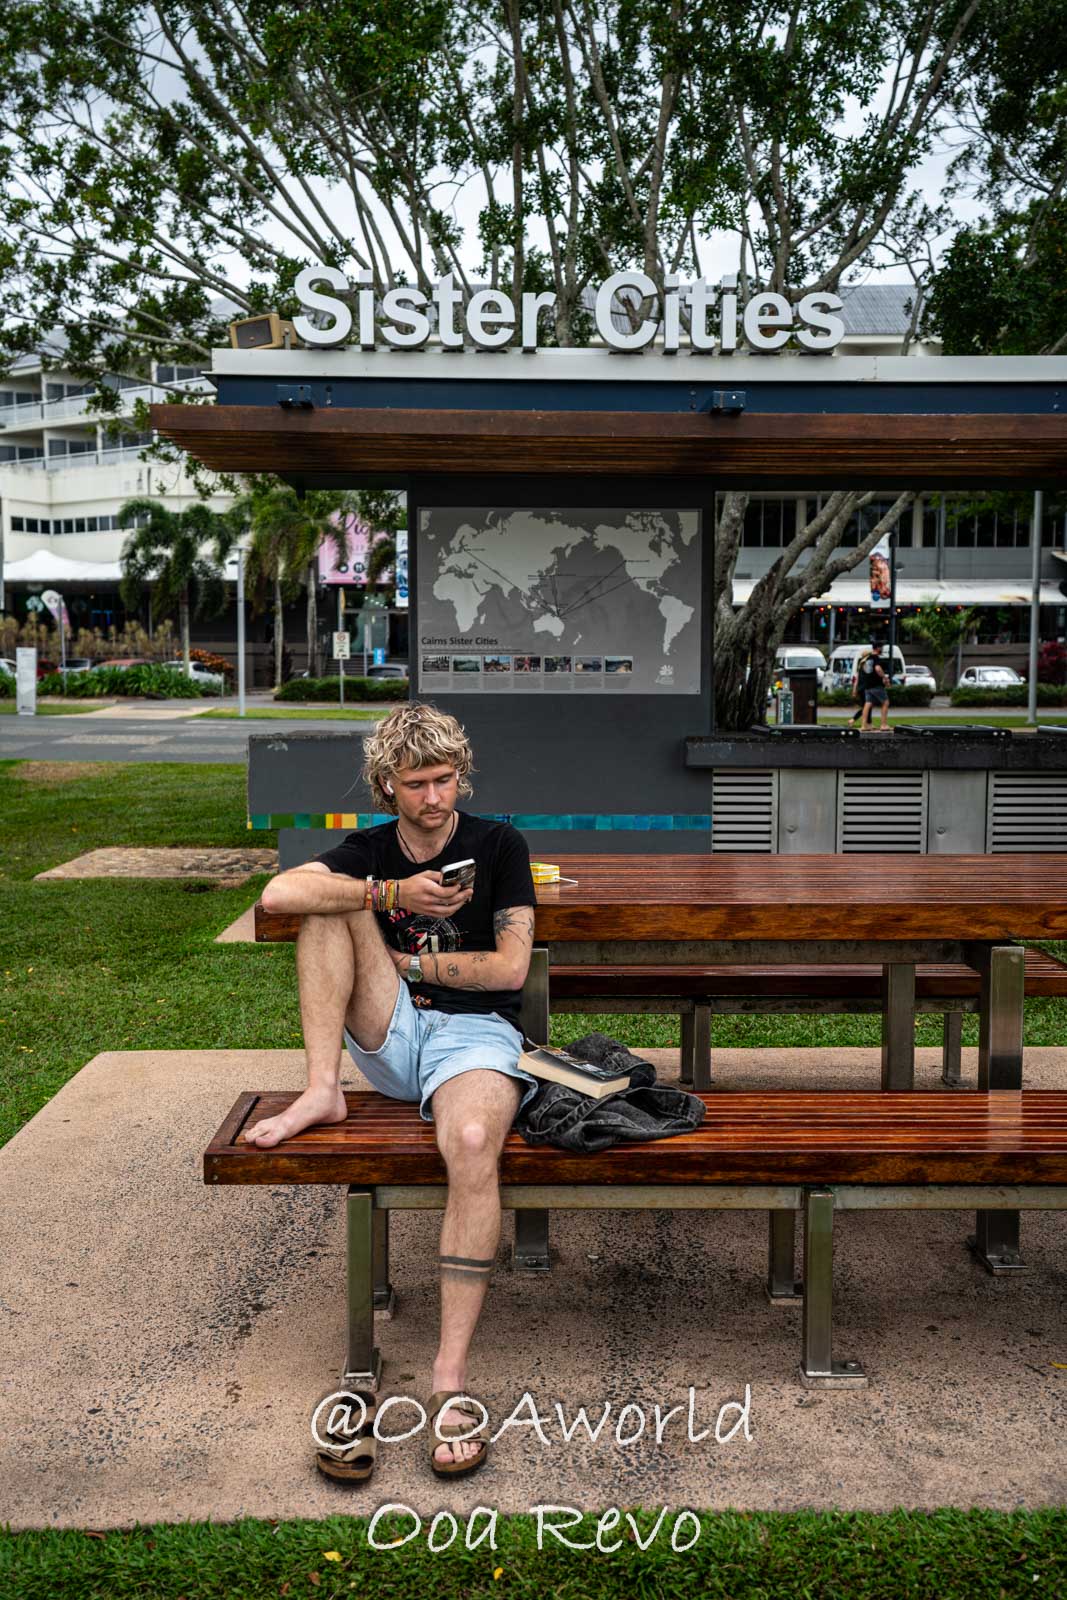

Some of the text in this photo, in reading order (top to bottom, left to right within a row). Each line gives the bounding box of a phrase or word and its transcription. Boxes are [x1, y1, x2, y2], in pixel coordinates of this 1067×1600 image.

[292, 266, 845, 356] Sister Cities
[421, 637, 499, 645] Cairns Sister Cities
